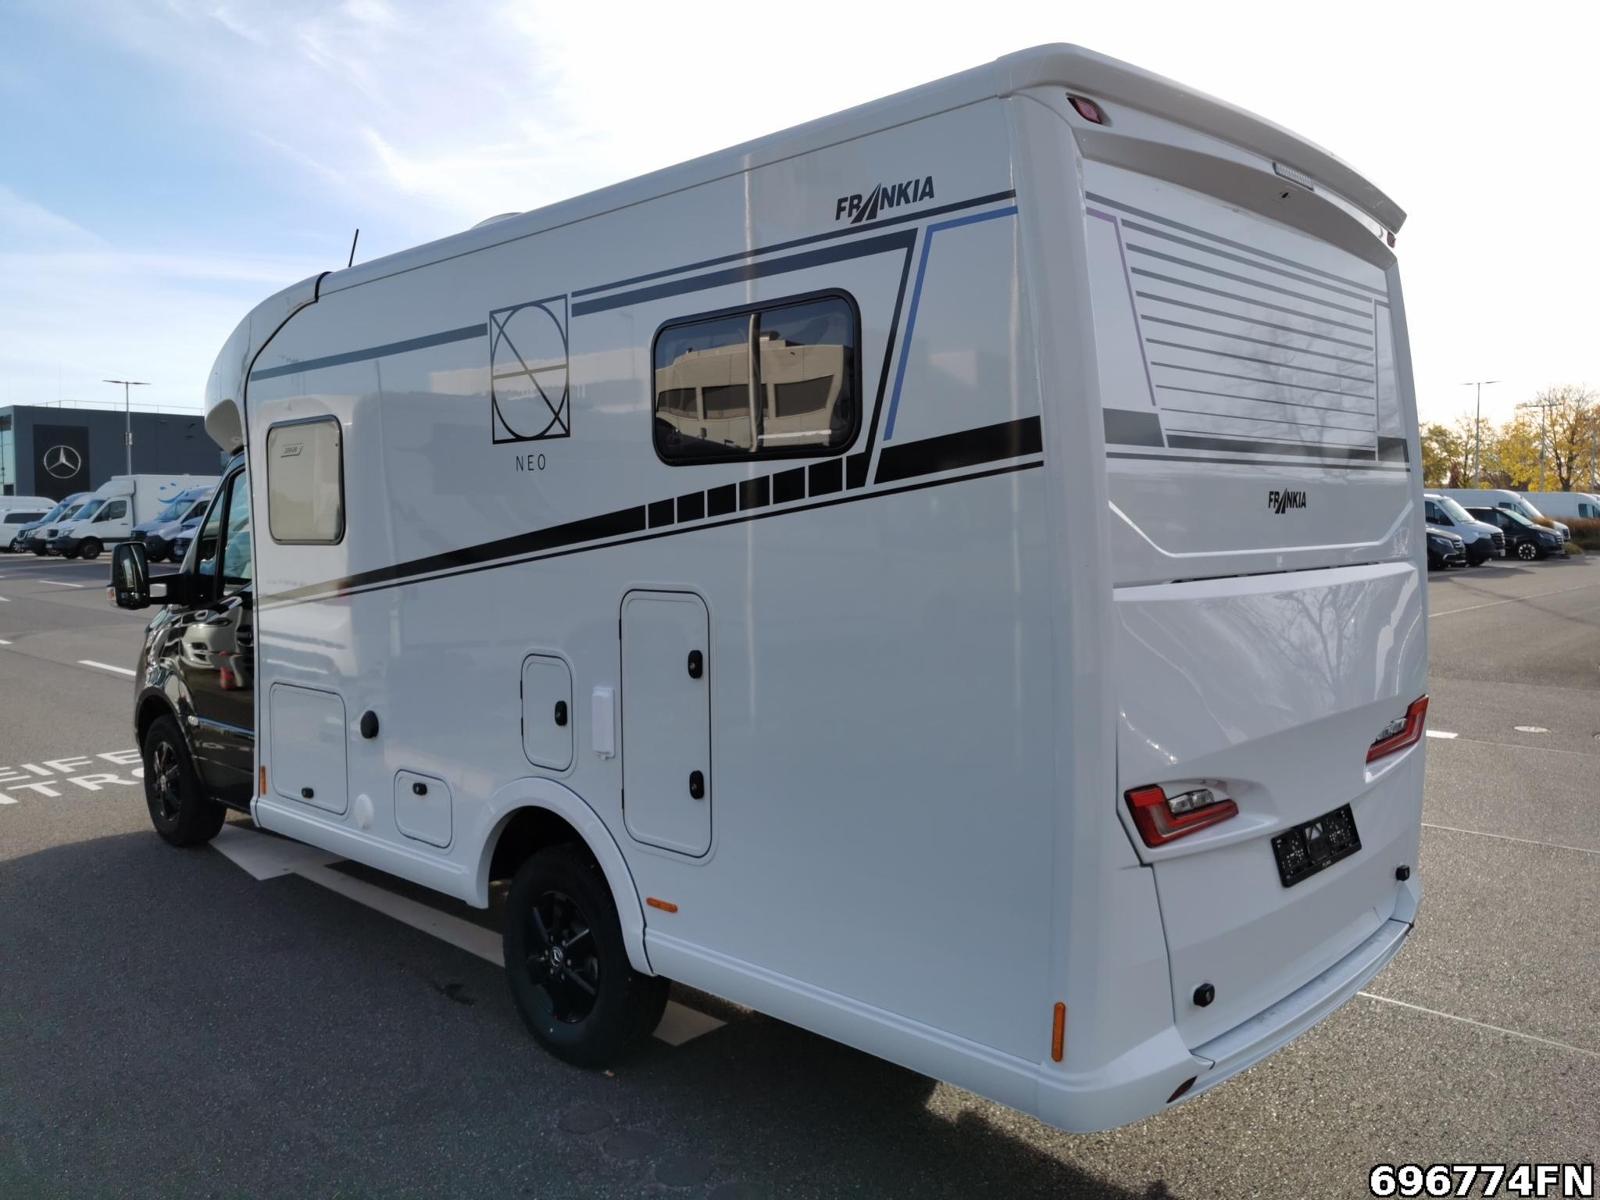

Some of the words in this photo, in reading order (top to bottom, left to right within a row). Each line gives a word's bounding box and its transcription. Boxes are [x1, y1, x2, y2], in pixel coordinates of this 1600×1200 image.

[835, 175, 935, 224] FRANKIA
[515, 453, 546, 472] NEO
[1268, 487, 1307, 514] FRANKIA
